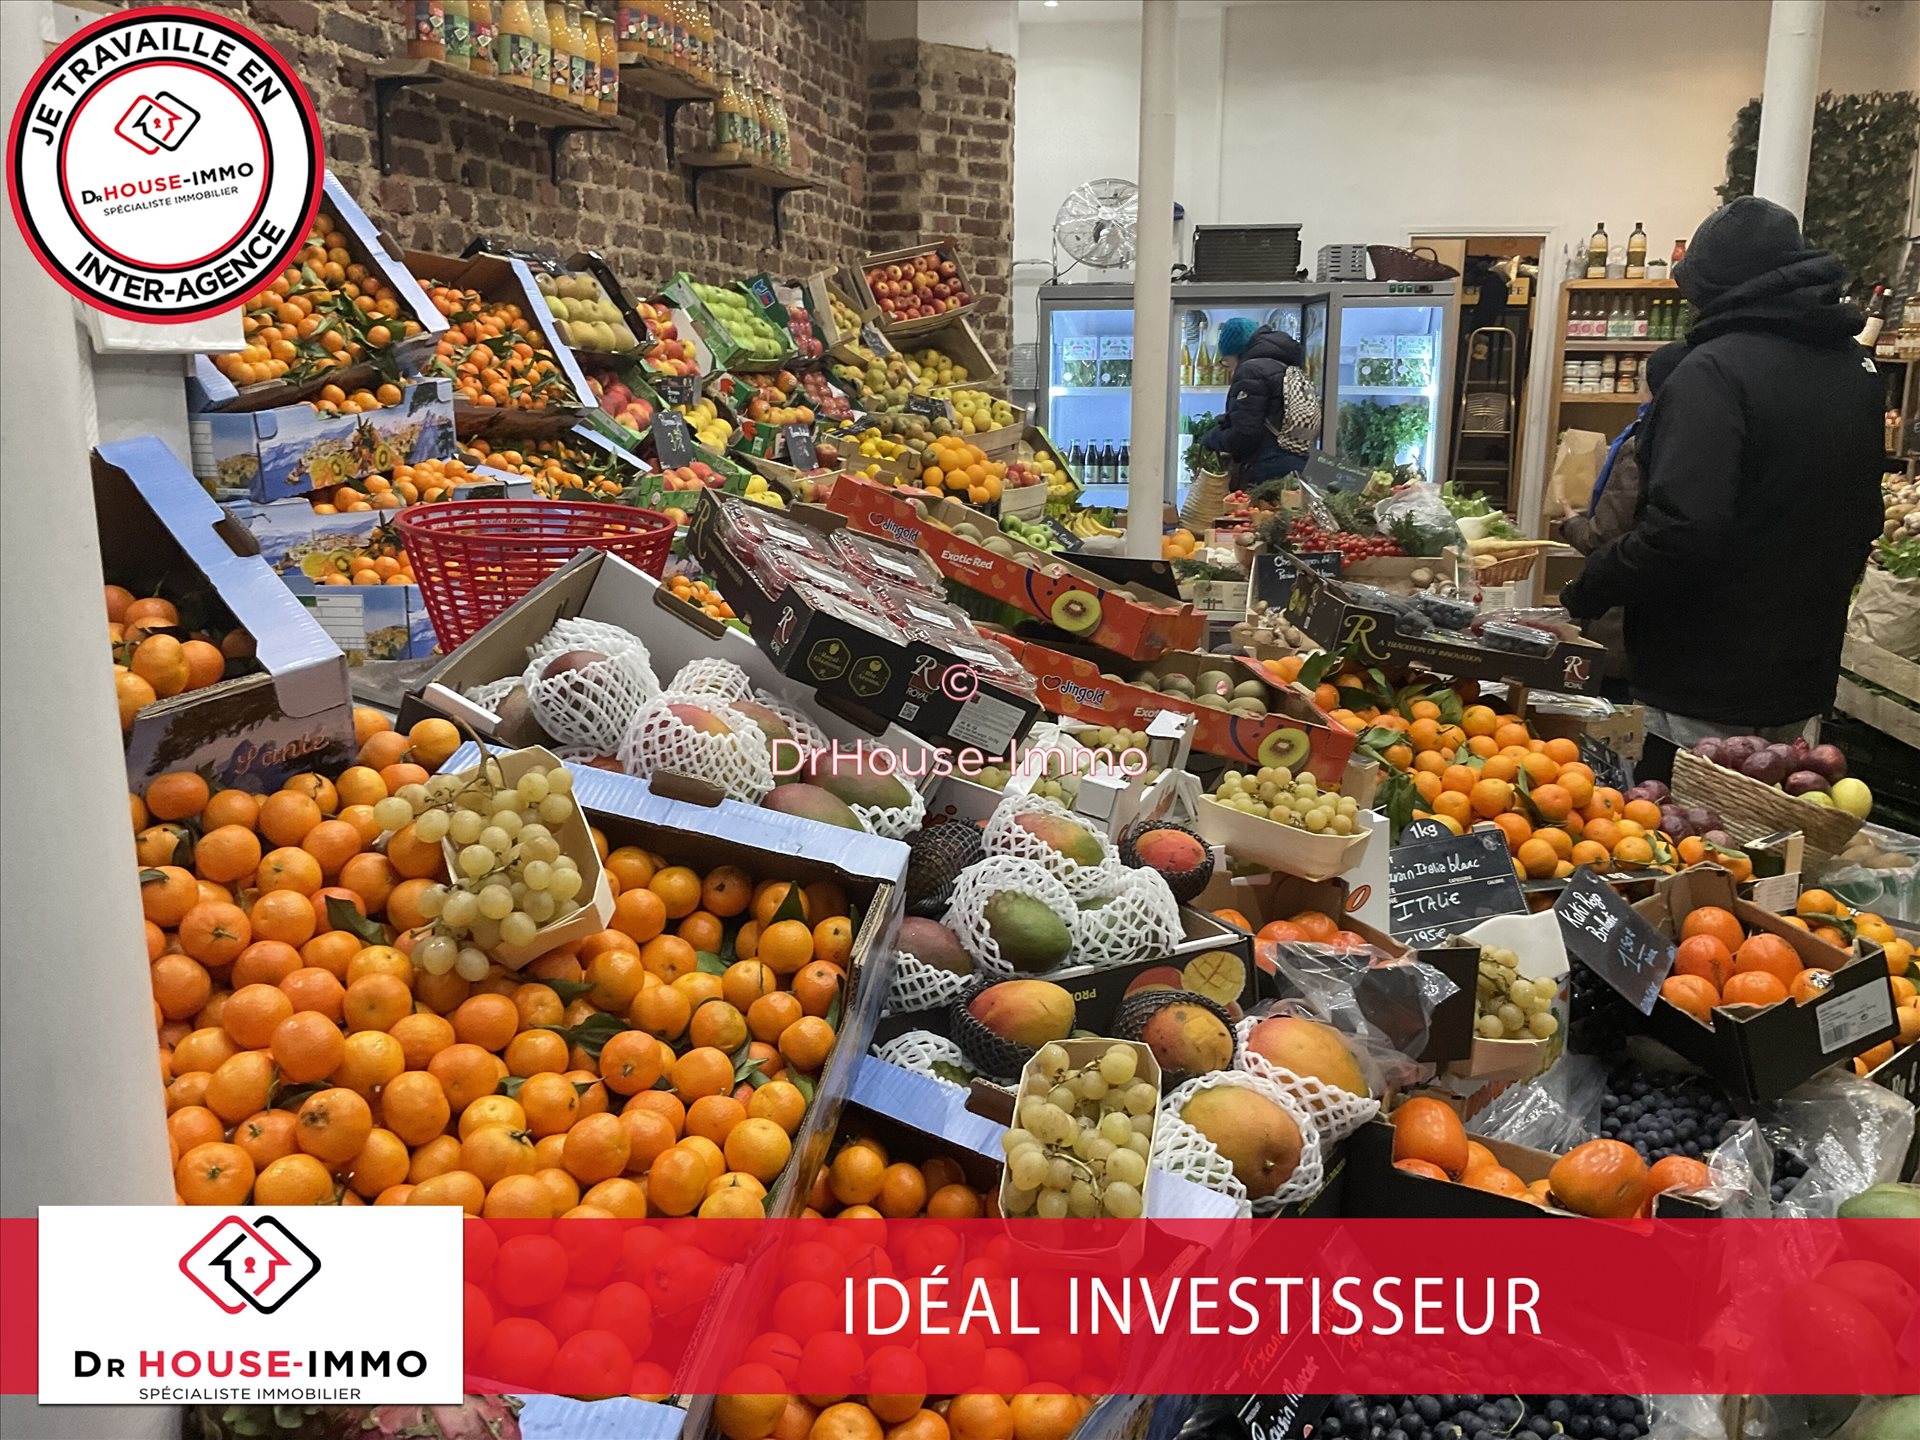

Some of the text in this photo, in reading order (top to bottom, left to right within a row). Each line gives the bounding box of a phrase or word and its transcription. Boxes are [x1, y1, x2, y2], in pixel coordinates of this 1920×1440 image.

[882, 518, 920, 541] Jingold
[941, 550, 971, 565] Exotic
[972, 557, 994, 570] Red
[1342, 614, 1391, 660] R
[906, 686, 929, 703] ROYAL
[1059, 680, 1106, 704] Jingold
[1410, 822, 1438, 839] 1kg
[1446, 853, 1480, 873] blanc
